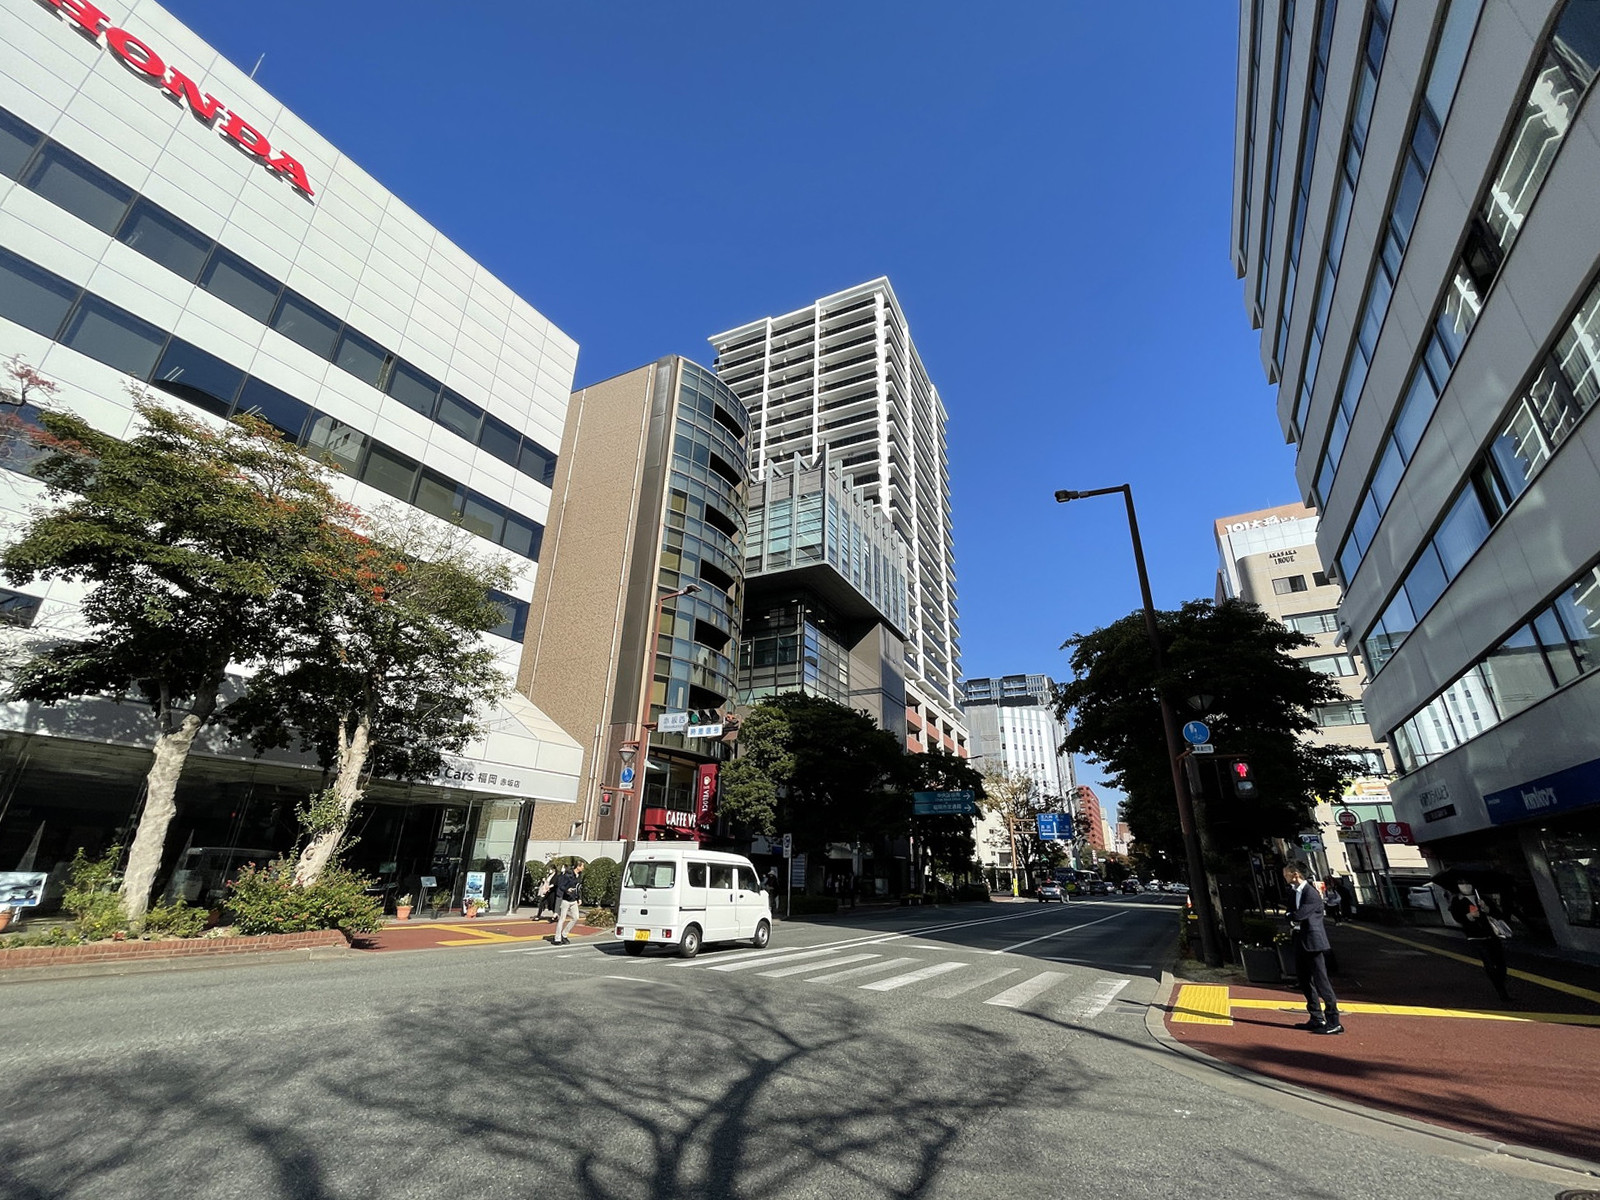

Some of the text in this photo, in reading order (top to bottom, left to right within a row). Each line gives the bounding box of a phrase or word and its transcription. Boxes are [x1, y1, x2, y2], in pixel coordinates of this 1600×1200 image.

[40, 0, 315, 200] HONDA
[1269, 550, 1297, 558] AKASAKA
[1274, 556, 1295, 565] INOUE
[445, 766, 474, 781] Cars
[478, 773, 497, 784] 福岡
[500, 778, 520, 788] 赤坂店
